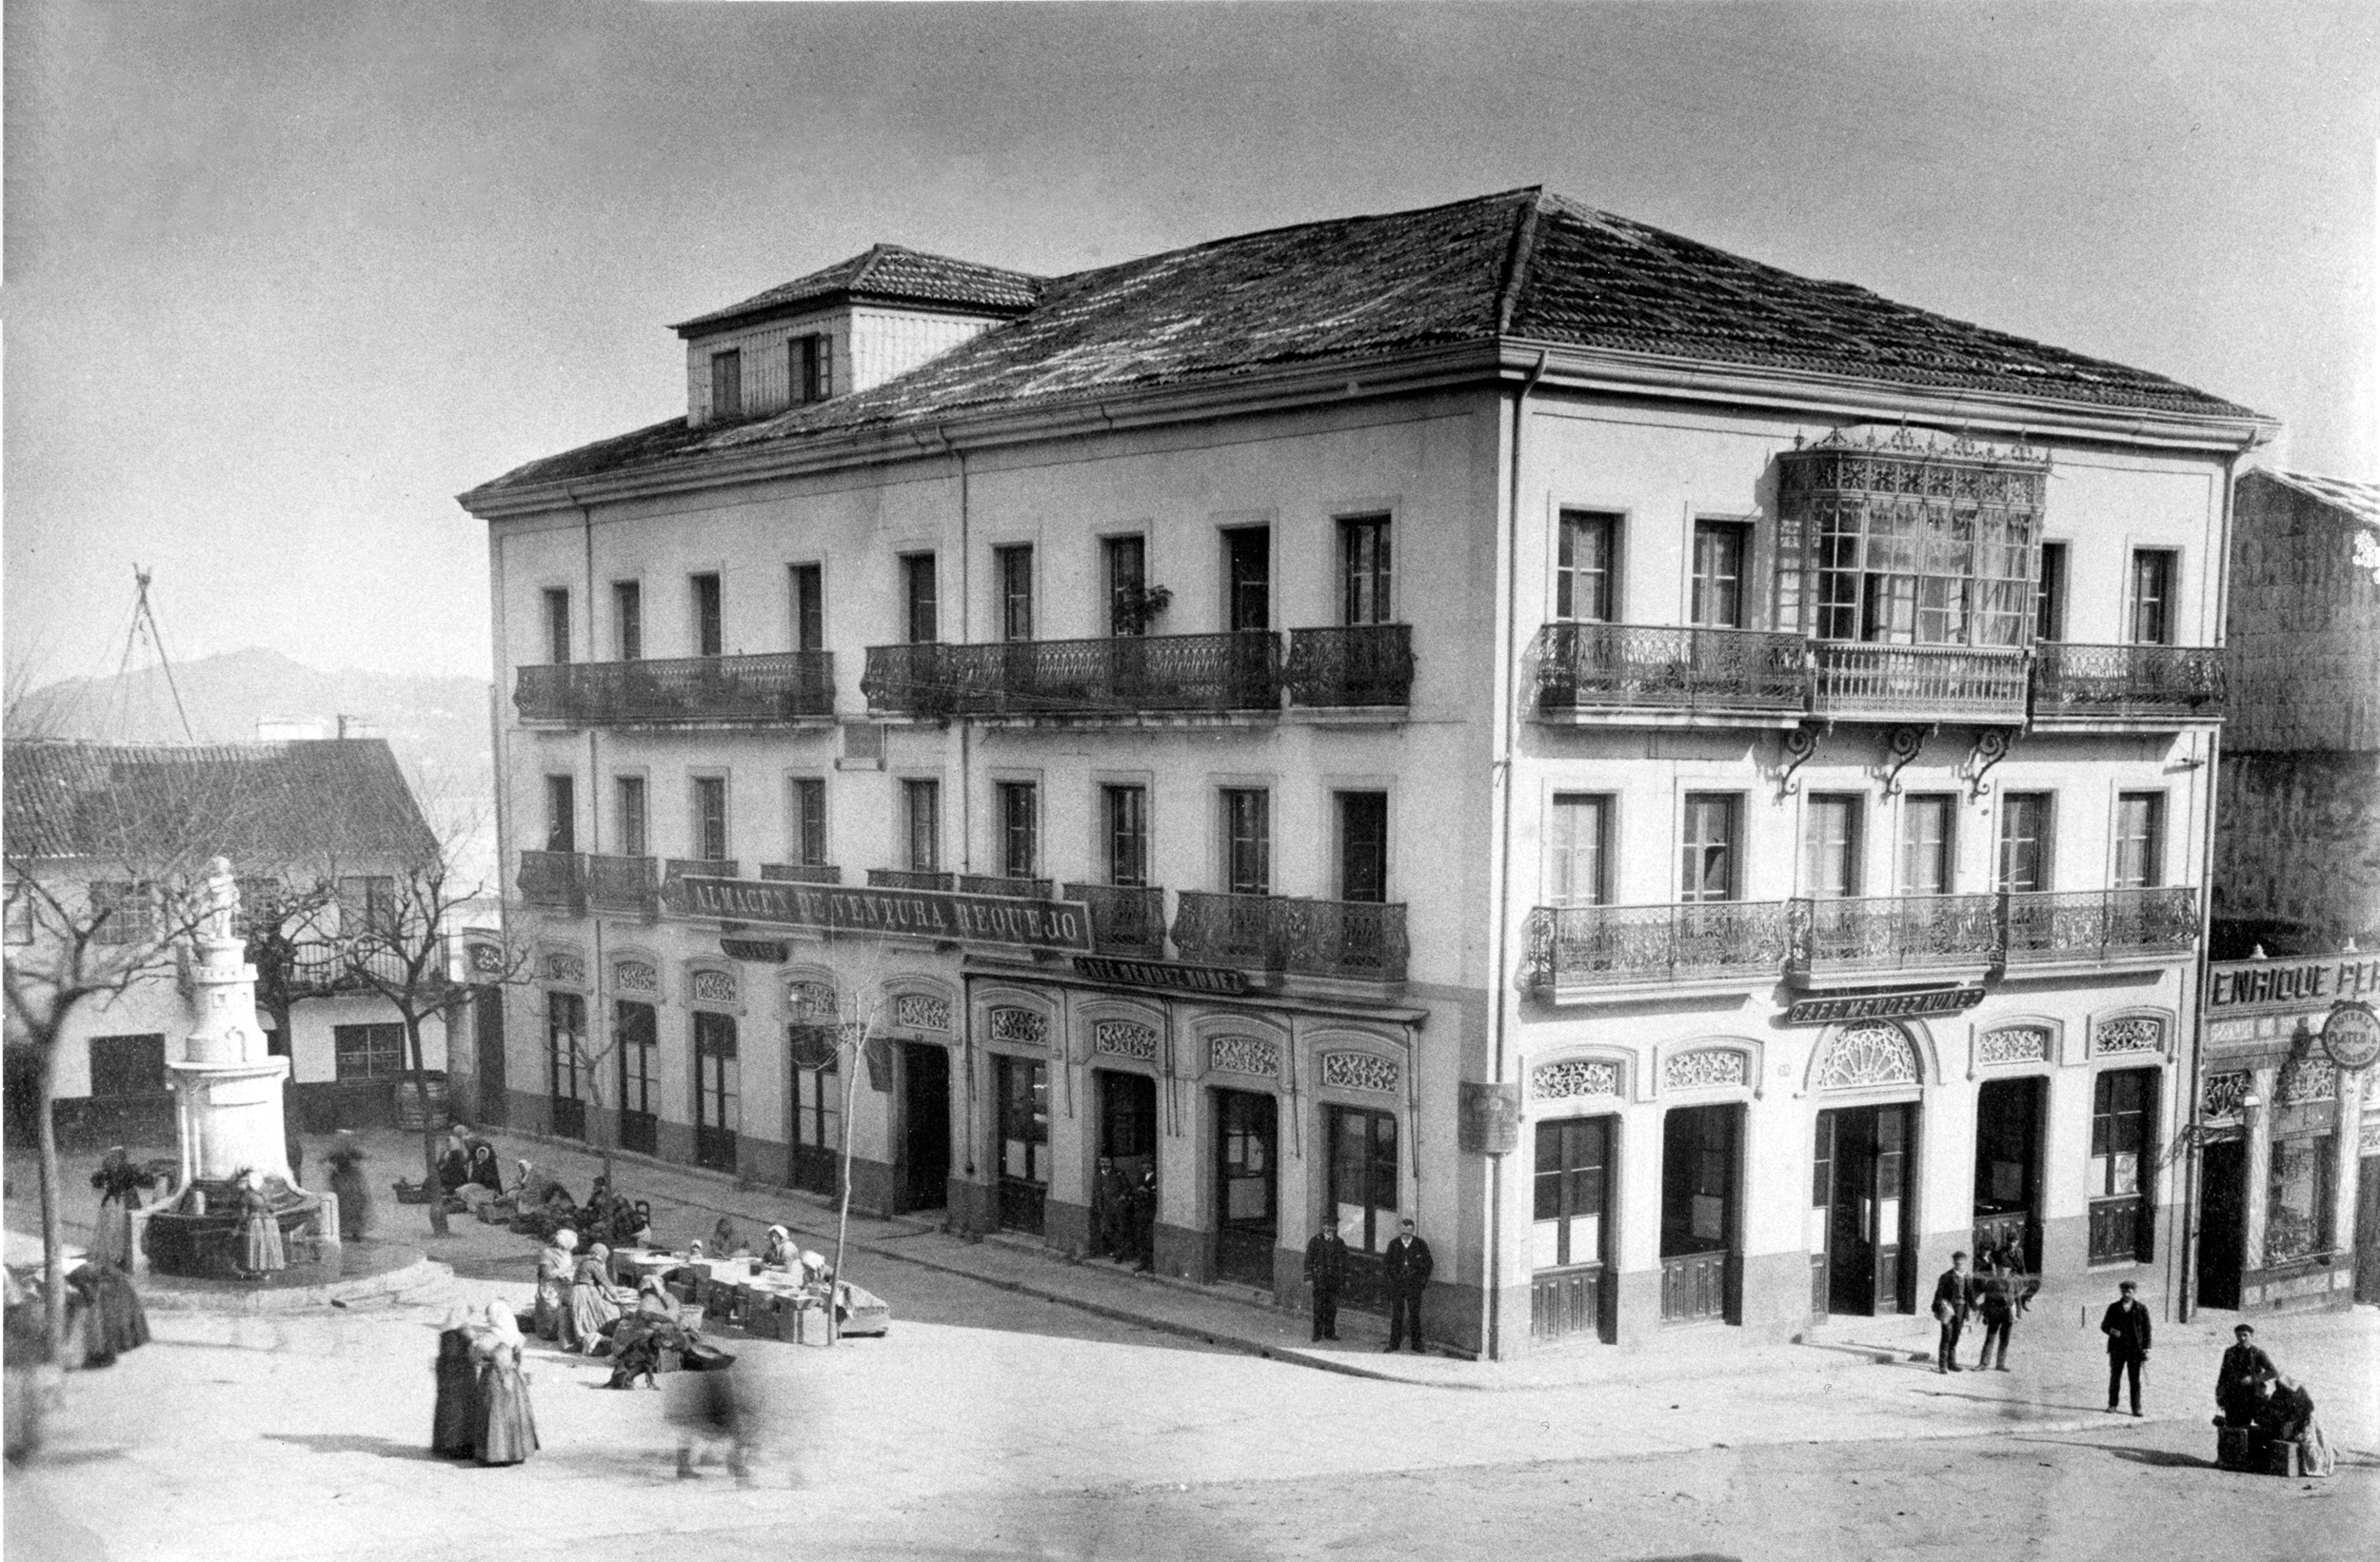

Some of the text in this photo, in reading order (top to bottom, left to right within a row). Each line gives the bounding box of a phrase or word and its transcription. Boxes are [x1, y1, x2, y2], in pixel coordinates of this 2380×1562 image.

[695, 884, 1078, 941] ALMACEN DE VENTURA REQUEJO
[2212, 965, 2332, 1006] ENRIQUE
